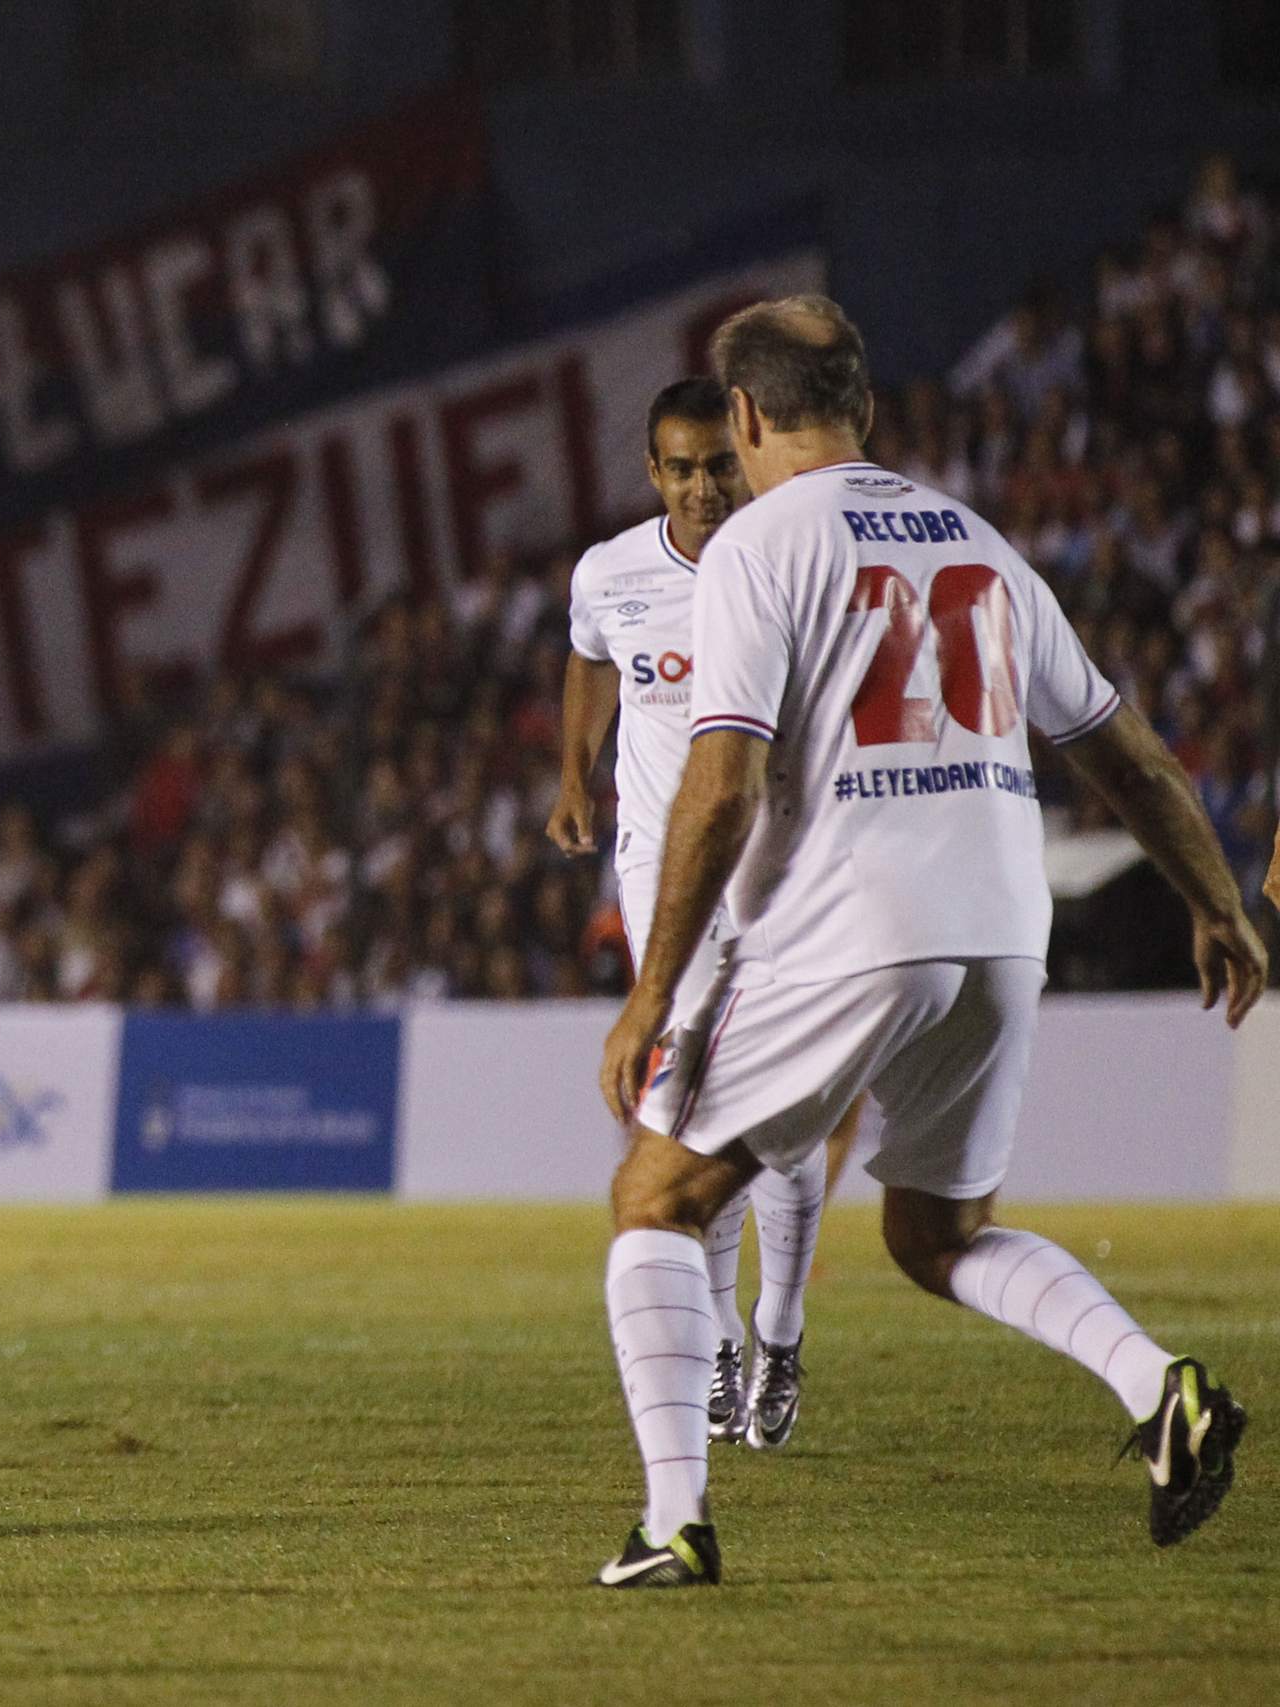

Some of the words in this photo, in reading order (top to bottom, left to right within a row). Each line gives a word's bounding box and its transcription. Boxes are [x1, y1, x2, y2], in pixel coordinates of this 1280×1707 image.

[842, 509, 970, 543] RECOBA
[632, 651, 693, 684] SO
[844, 564, 1021, 747] 20
